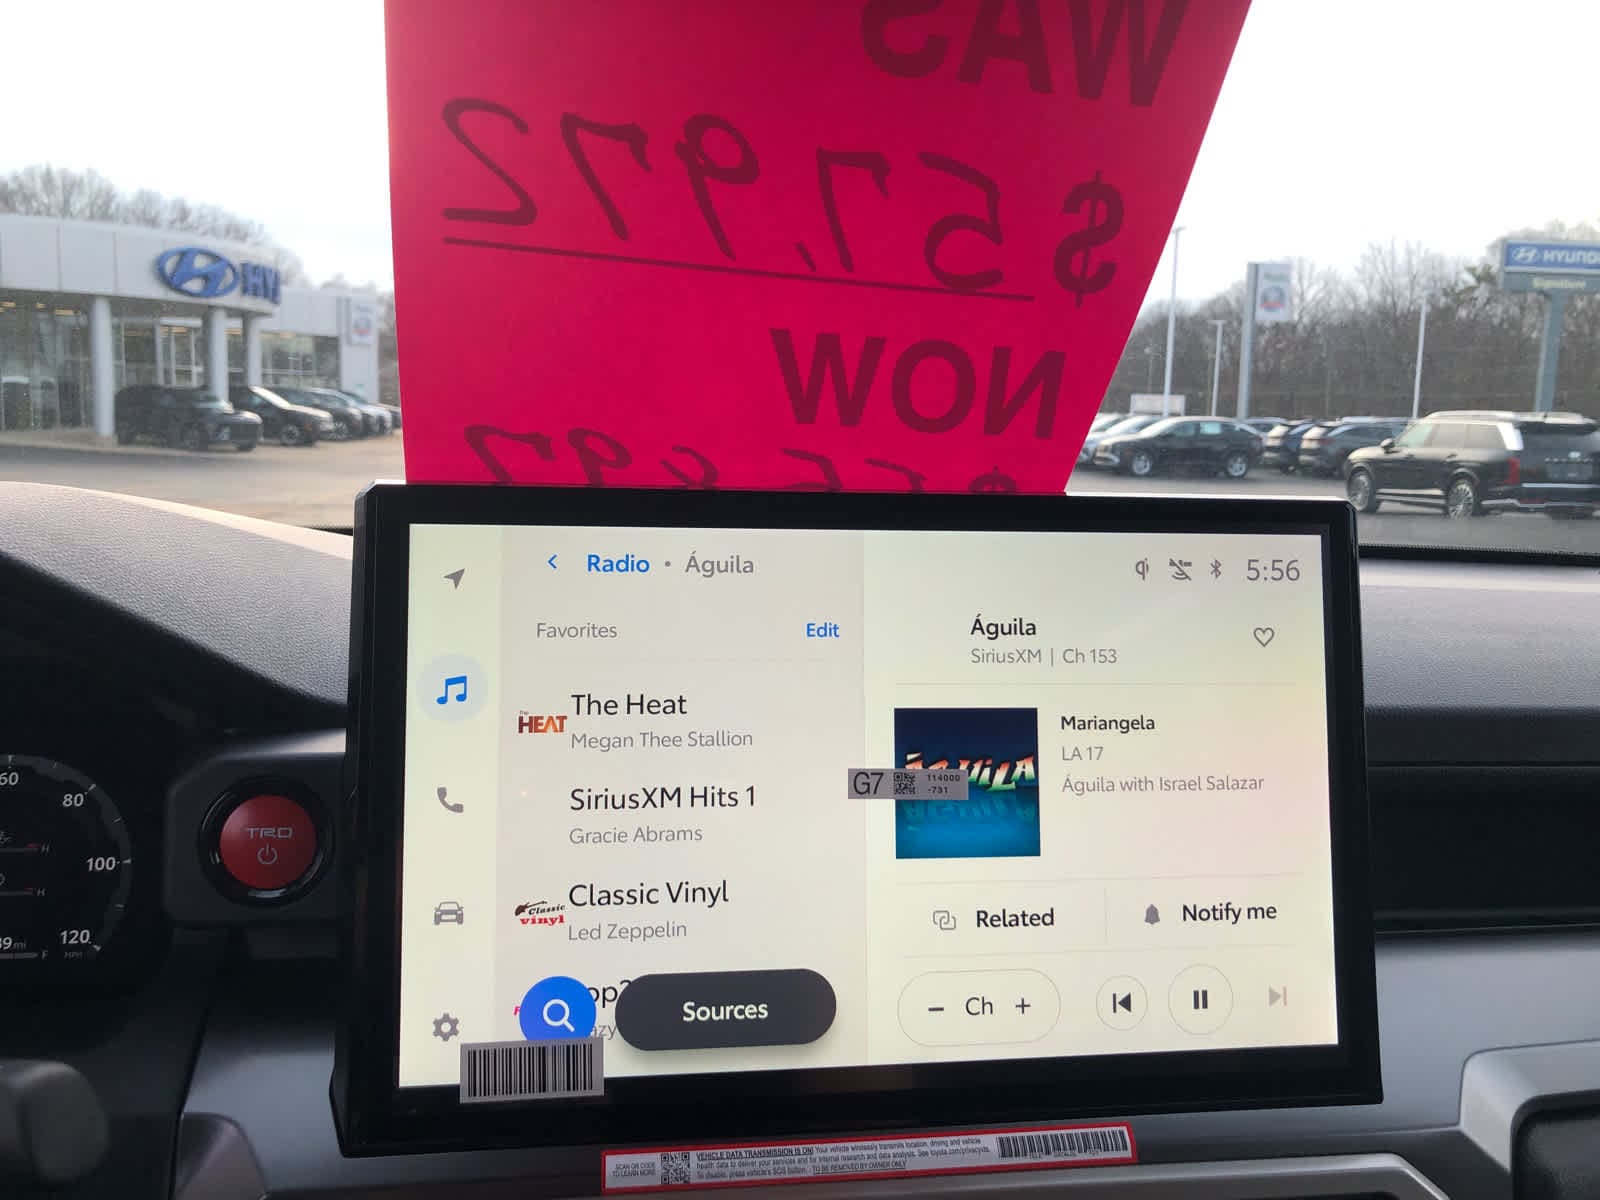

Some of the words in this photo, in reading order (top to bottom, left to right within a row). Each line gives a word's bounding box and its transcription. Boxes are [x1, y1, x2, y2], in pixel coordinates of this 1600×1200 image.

[587, 554, 650, 573] Radio
[685, 551, 754, 577] Águila
[1247, 559, 1300, 581] 5:56
[536, 622, 617, 639] Favorites
[806, 622, 840, 638] Edit
[970, 613, 1037, 641] Águila
[970, 648, 1042, 665] SiriusXM
[1062, 648, 1086, 664] Ch
[1090, 648, 1118, 664] 153
[571, 694, 618, 716] The
[626, 693, 688, 715] Heat
[518, 715, 567, 733] HEAT
[1061, 715, 1156, 734] Mariangela
[571, 732, 634, 752] Megan
[640, 731, 682, 749] Thee
[688, 730, 753, 748] Stallion
[1061, 746, 1085, 761] LA
[1087, 746, 1104, 761] 17
[853, 772, 884, 795] G7
[928, 774, 961, 782] 114000
[1062, 774, 1116, 795] Águila
[1119, 776, 1154, 792] with
[1159, 775, 1203, 792] Israel
[1206, 774, 1264, 792] Salazar
[62, 793, 84, 807] 80
[570, 787, 681, 811] SiriusXM
[690, 785, 738, 808] Hits
[746, 786, 756, 807] 1
[245, 827, 293, 839] TRD
[569, 827, 628, 845] Gracie
[633, 825, 703, 843] Abrams
[87, 856, 116, 871] 100
[568, 882, 659, 907] Classic
[666, 880, 729, 907] Vinyl
[520, 914, 565, 926] vinyl
[528, 904, 566, 916] Classic
[976, 907, 1055, 928] Related
[1182, 903, 1241, 925] Notify
[1246, 905, 1278, 920] me
[60, 929, 90, 944] 120
[568, 922, 601, 941] Led
[607, 921, 688, 944] Zeppelin
[682, 1001, 769, 1022] Sources
[965, 997, 994, 1017] Ch
